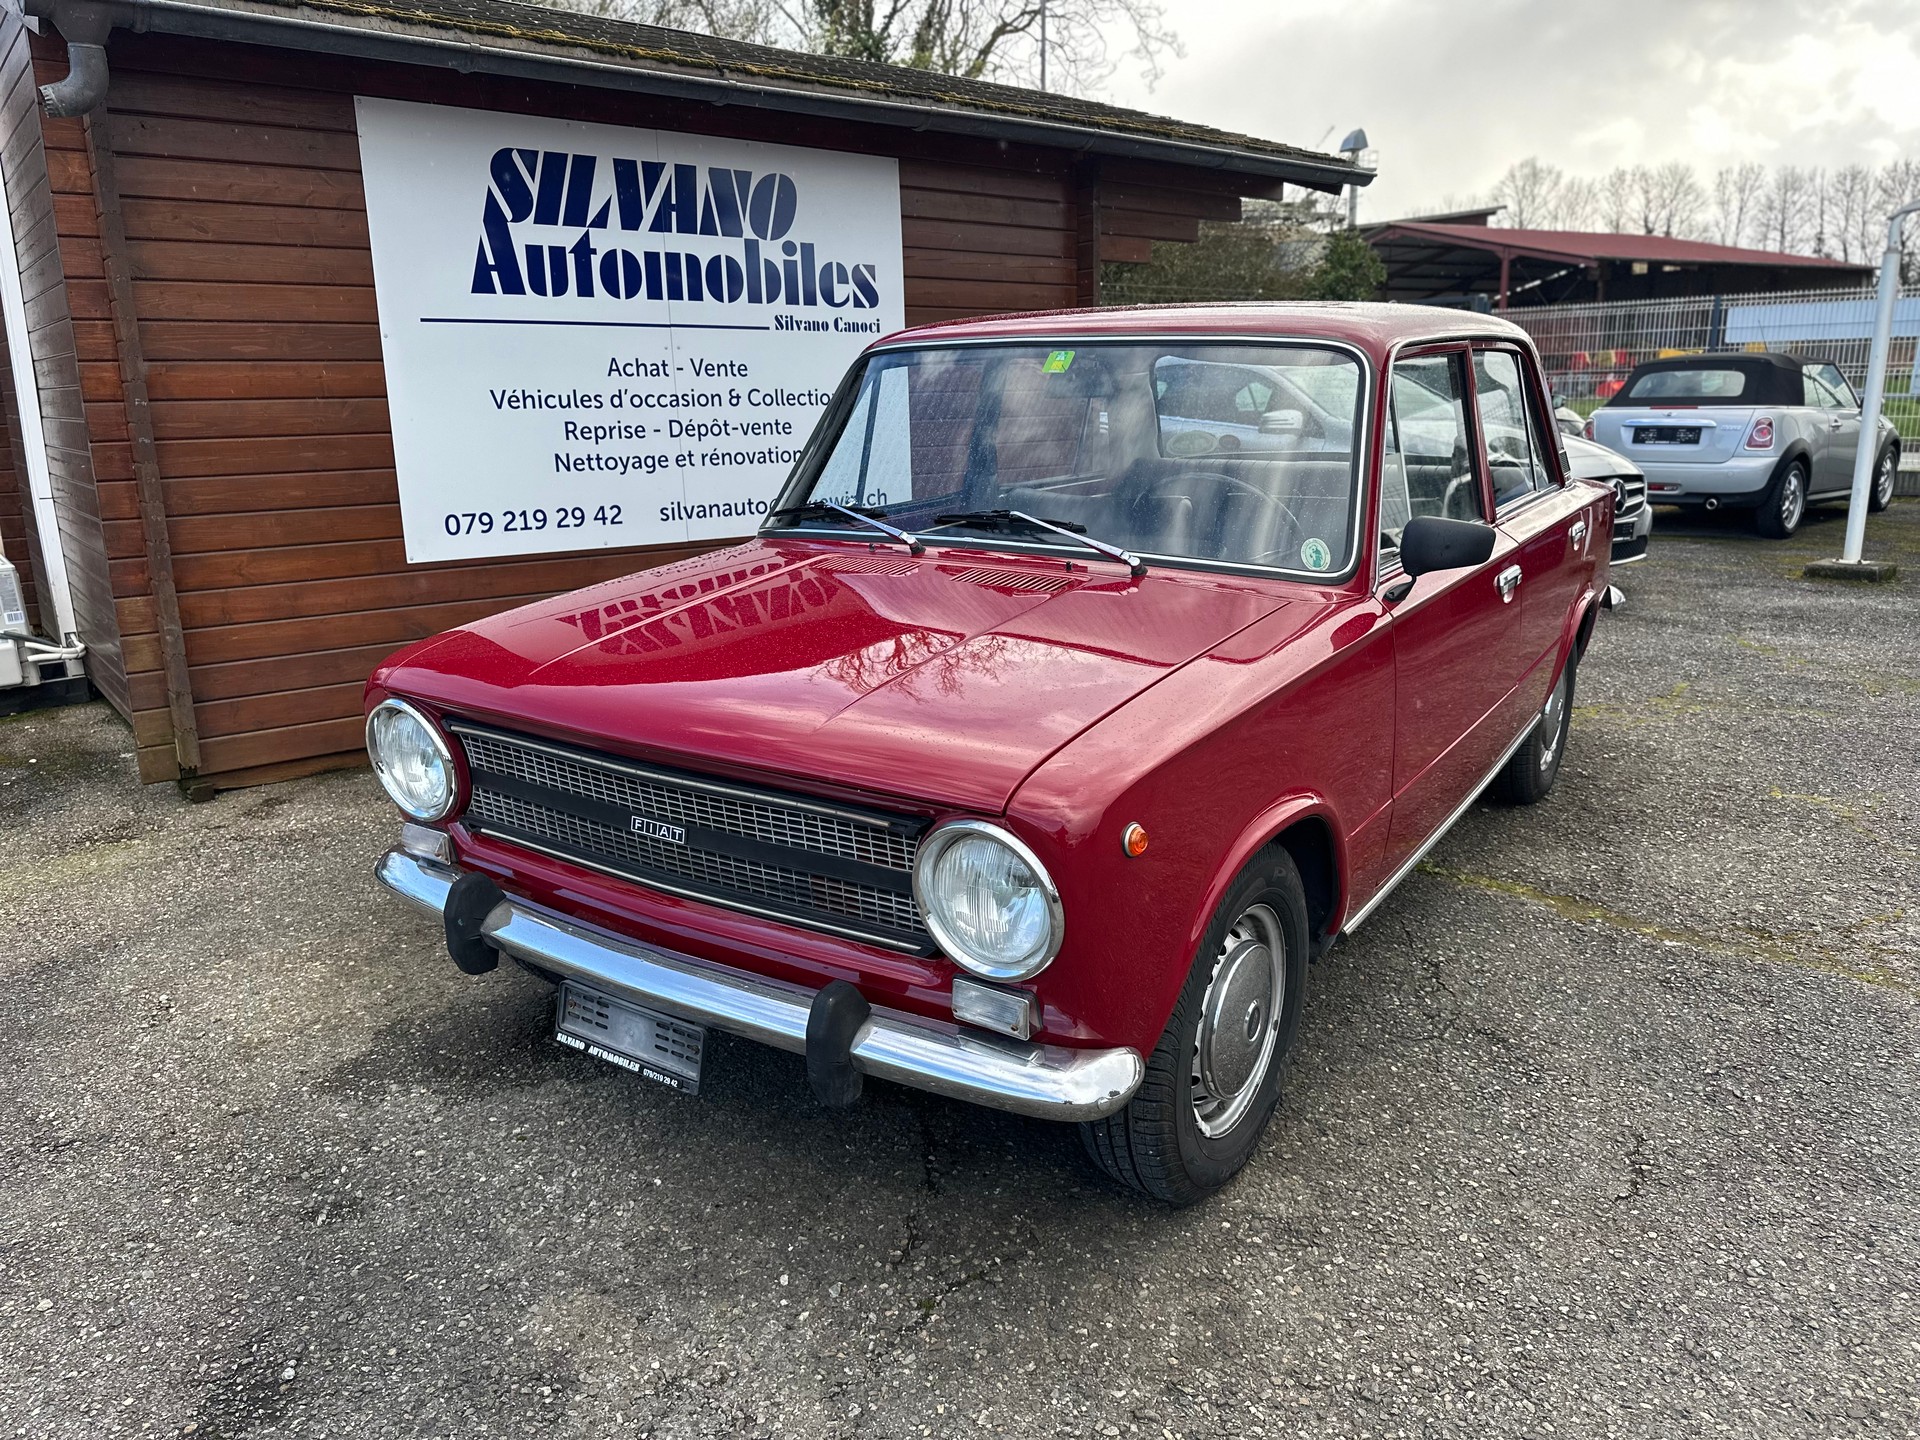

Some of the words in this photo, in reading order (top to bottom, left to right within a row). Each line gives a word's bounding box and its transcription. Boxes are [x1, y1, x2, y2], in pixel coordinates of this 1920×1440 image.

[485, 146, 798, 242] SILVANO
[470, 220, 880, 309] Automobiles
[774, 314, 830, 332] Silvano
[833, 316, 881, 333] Canoci
[607, 357, 670, 377] Achat
[690, 358, 749, 378] Vente
[489, 388, 604, 410] Véhicules
[728, 388, 742, 407] &
[747, 388, 834, 407] Collectio
[564, 420, 647, 445] Reprise
[668, 418, 793, 441] Dépôt-vente
[554, 452, 669, 476] Nettoyage
[675, 450, 696, 468] et
[444, 511, 494, 536] 079
[502, 508, 548, 532] 219
[556, 506, 586, 528] 29
[593, 504, 623, 526] 42
[634, 819, 682, 841] FIAT
[556, 1032, 585, 1050] SILVANO
[588, 1045, 639, 1071] AUTOMOBILES
